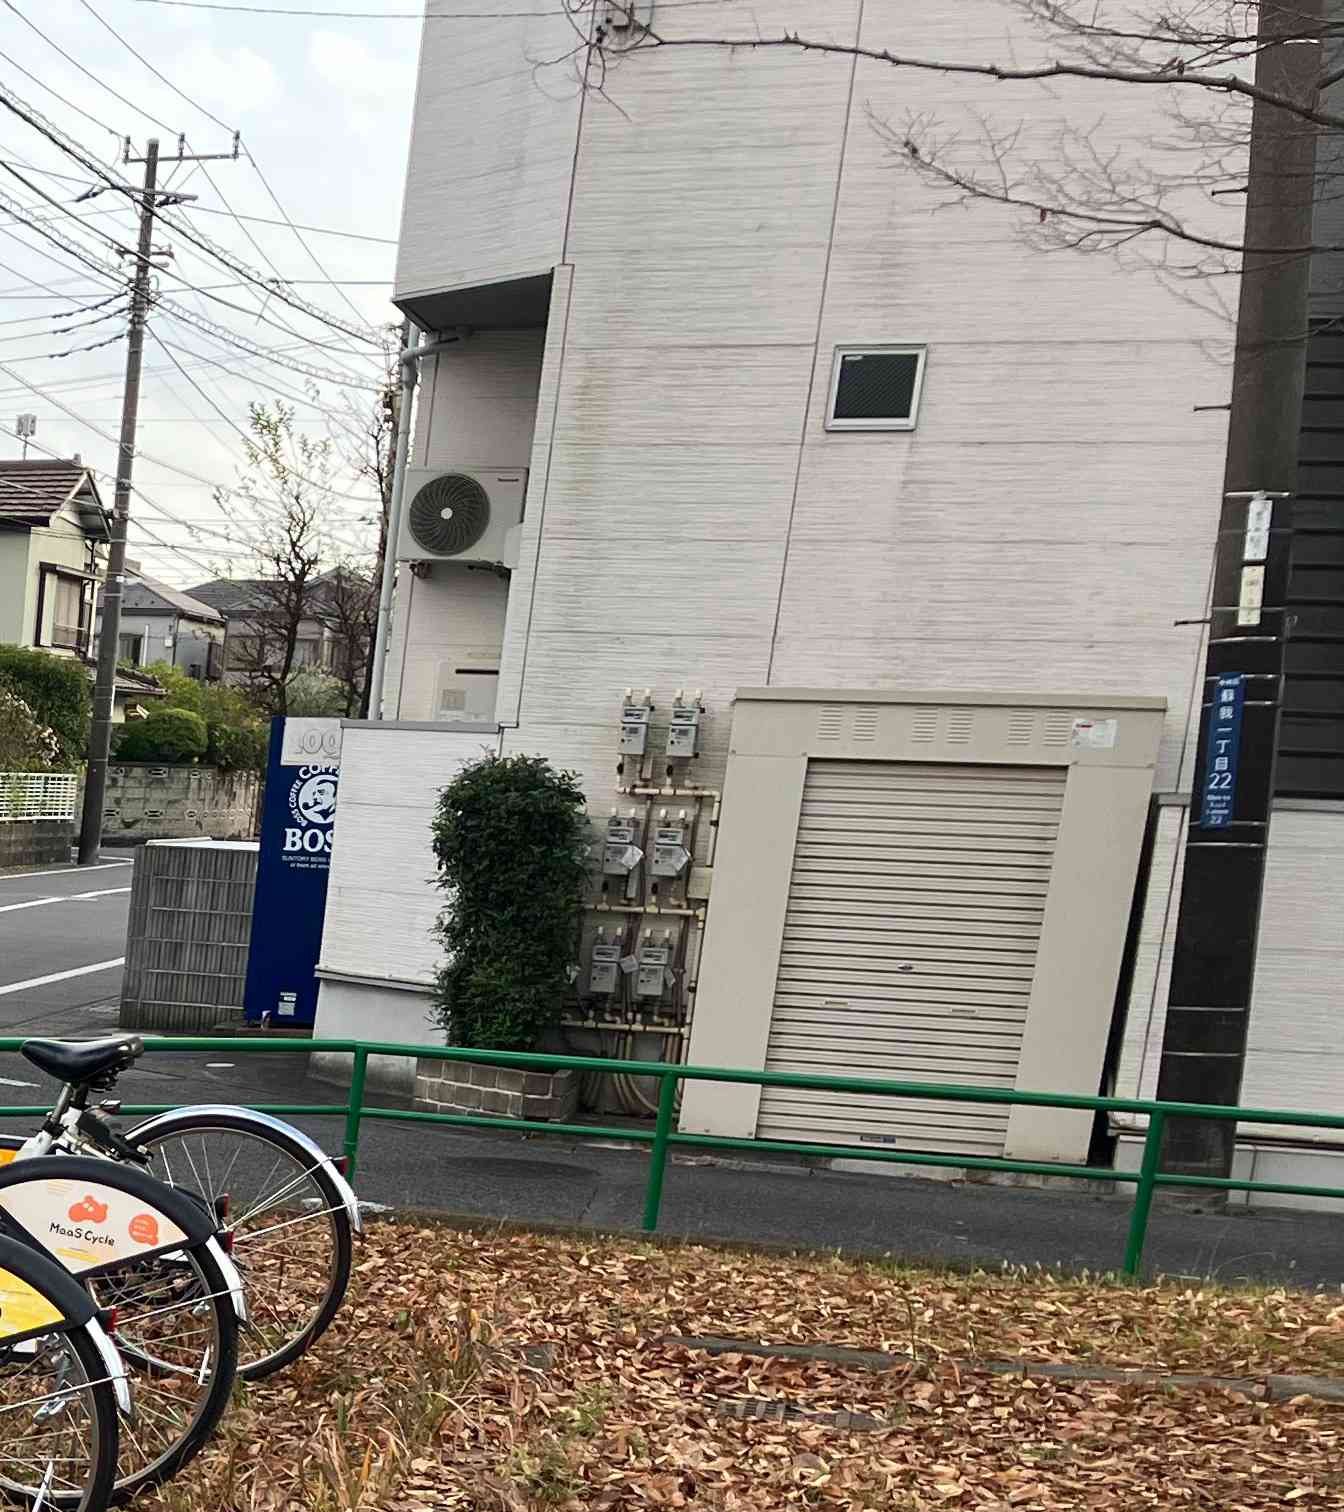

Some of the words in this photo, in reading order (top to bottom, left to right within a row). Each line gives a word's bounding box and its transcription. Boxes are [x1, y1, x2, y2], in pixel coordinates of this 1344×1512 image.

[1209, 772, 1232, 789] 22
[49, 1222, 82, 1239] MaaS
[83, 1230, 116, 1248] Cycle
